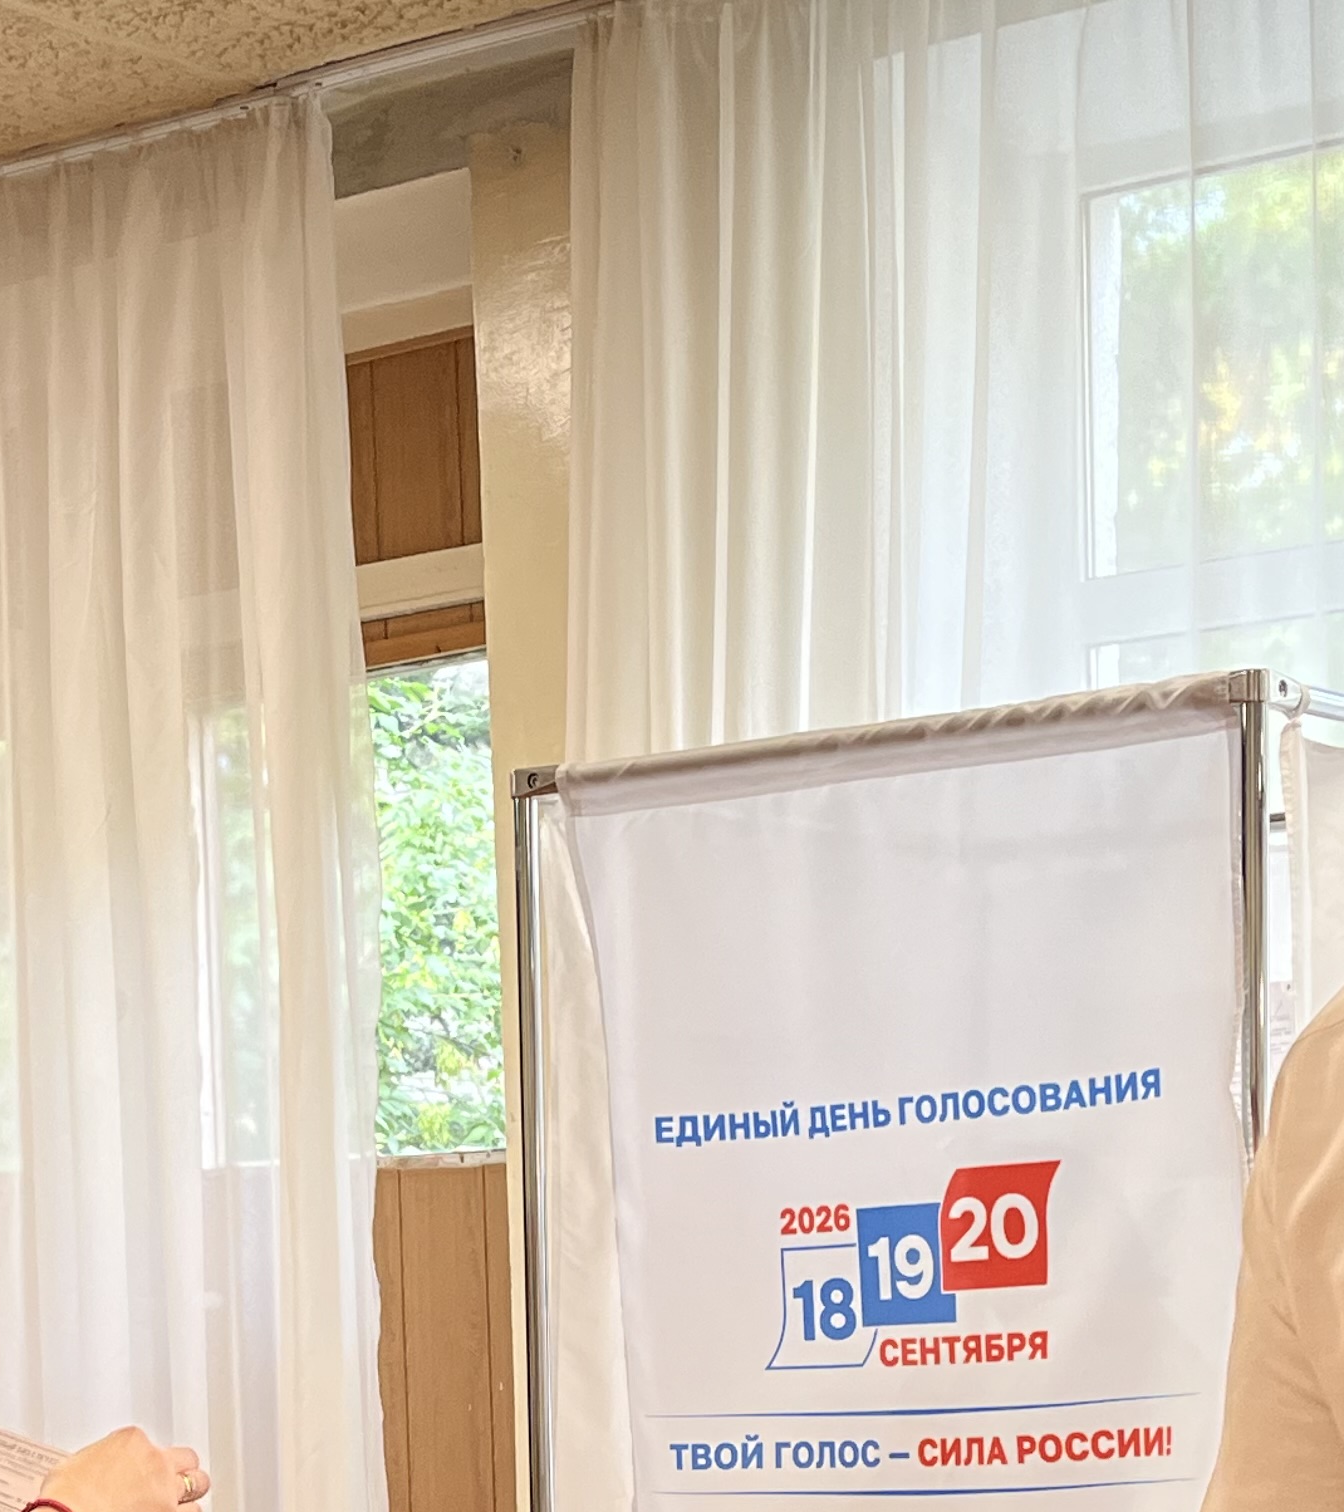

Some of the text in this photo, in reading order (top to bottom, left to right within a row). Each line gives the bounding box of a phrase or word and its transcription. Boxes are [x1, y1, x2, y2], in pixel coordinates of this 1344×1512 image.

[655, 1068, 1162, 1147] ЕДИНЫЙ ДЕНЬ ГОЛОСОВАНИЯ
[780, 1203, 852, 1236] 2026
[792, 1193, 1039, 1341] 18 19 20
[879, 1330, 1049, 1367] СЕНТЯБРЯ
[670, 1435, 764, 1470] ТВОЙ
[775, 1440, 881, 1468] ГОЛОС
[918, 1436, 1009, 1468] СИЛА
[1016, 1426, 1173, 1465] РОССИИ!
